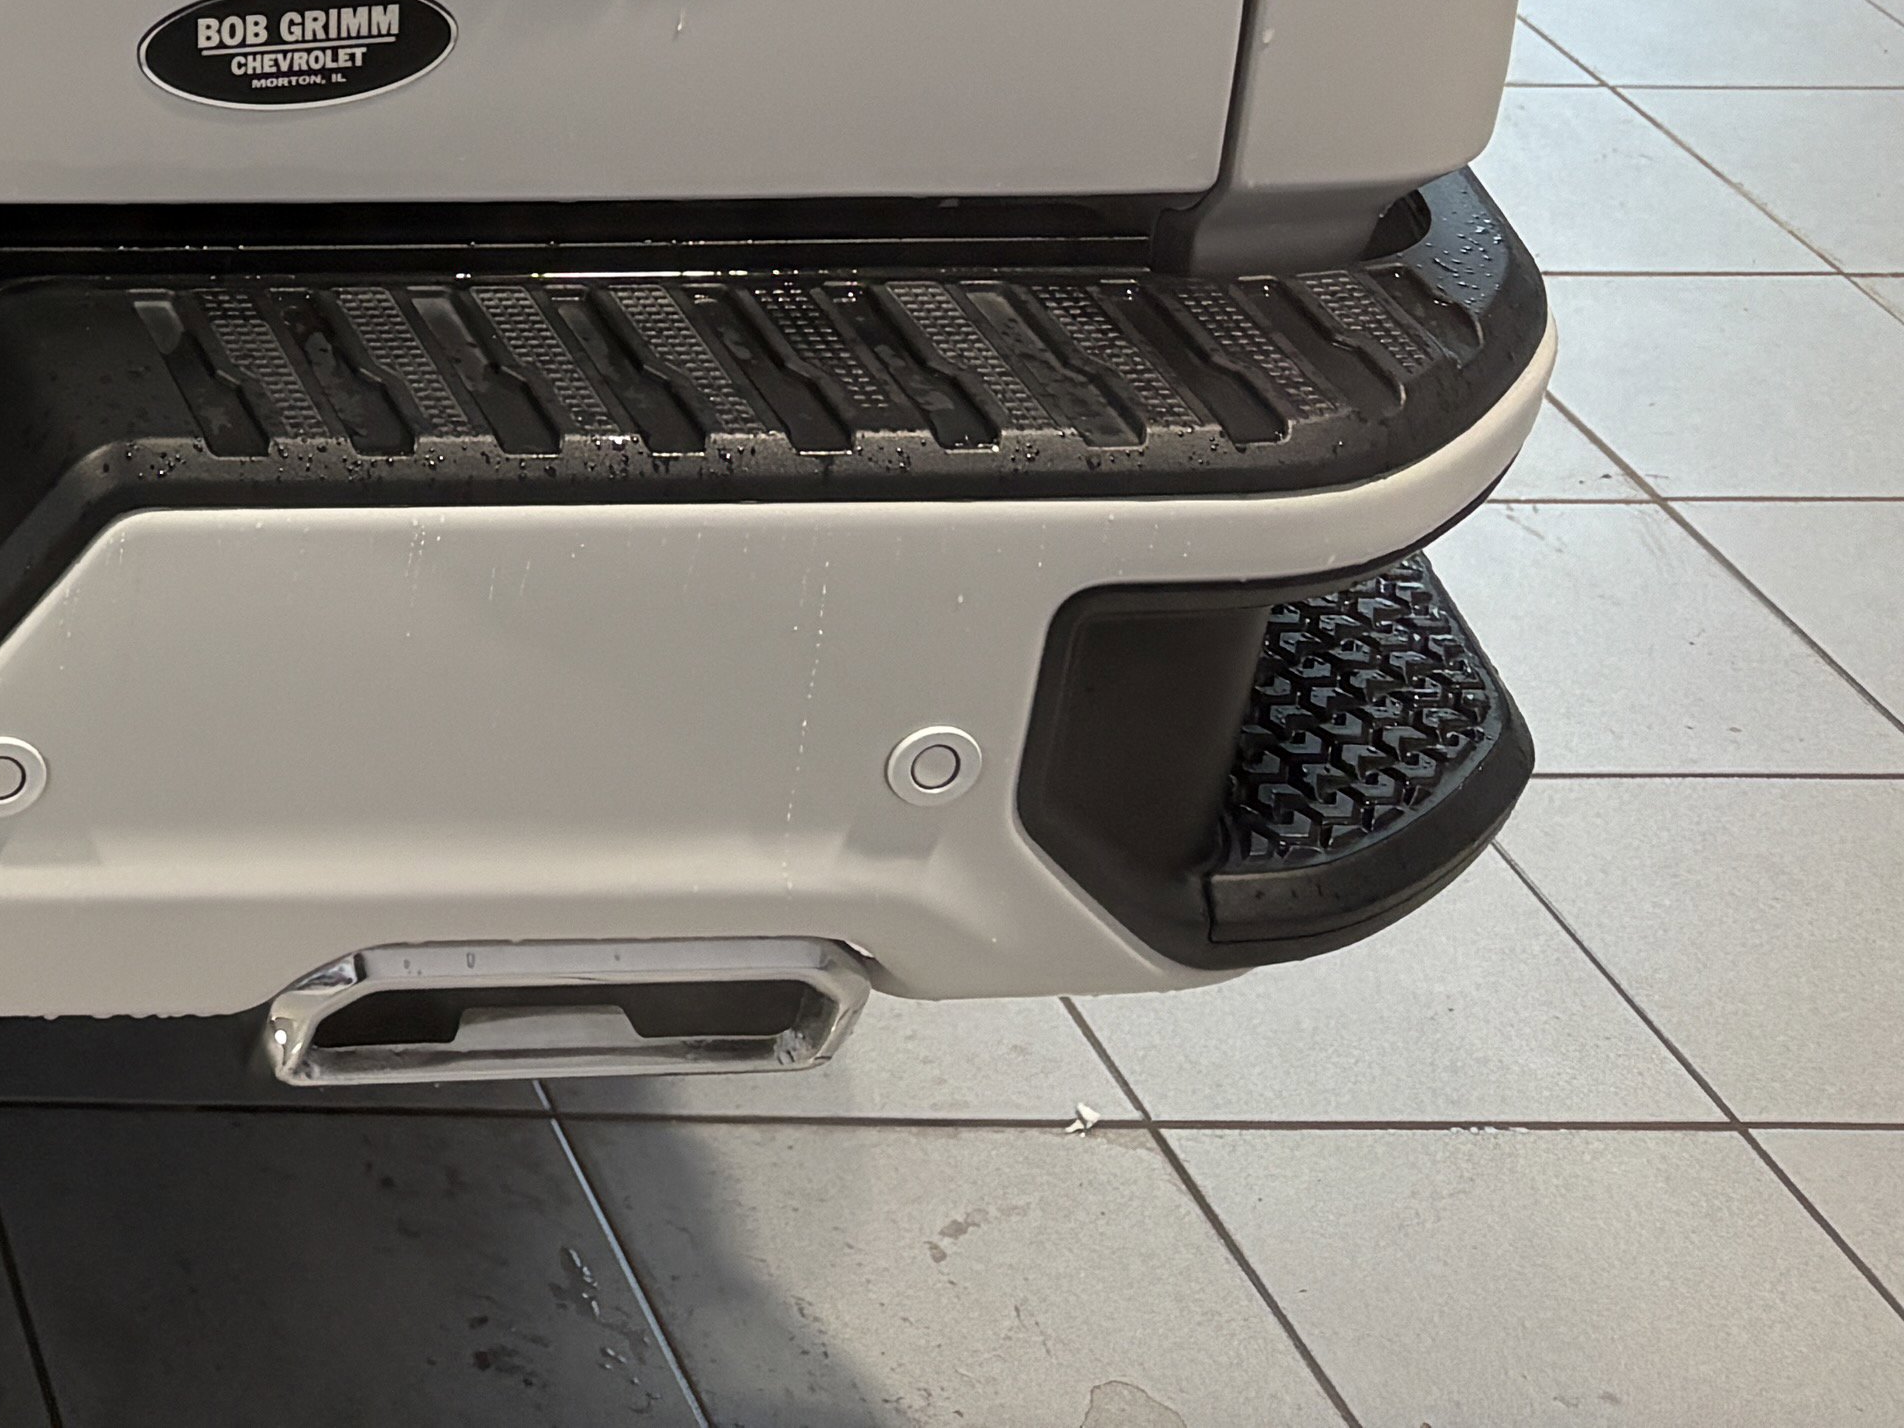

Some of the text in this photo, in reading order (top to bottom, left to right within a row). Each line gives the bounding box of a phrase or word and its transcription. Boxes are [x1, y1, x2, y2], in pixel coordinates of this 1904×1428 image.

[197, 4, 400, 48] BOB GRIMM
[231, 47, 367, 75] CHEVROLET
[252, 73, 346, 88] MORTON, IL
